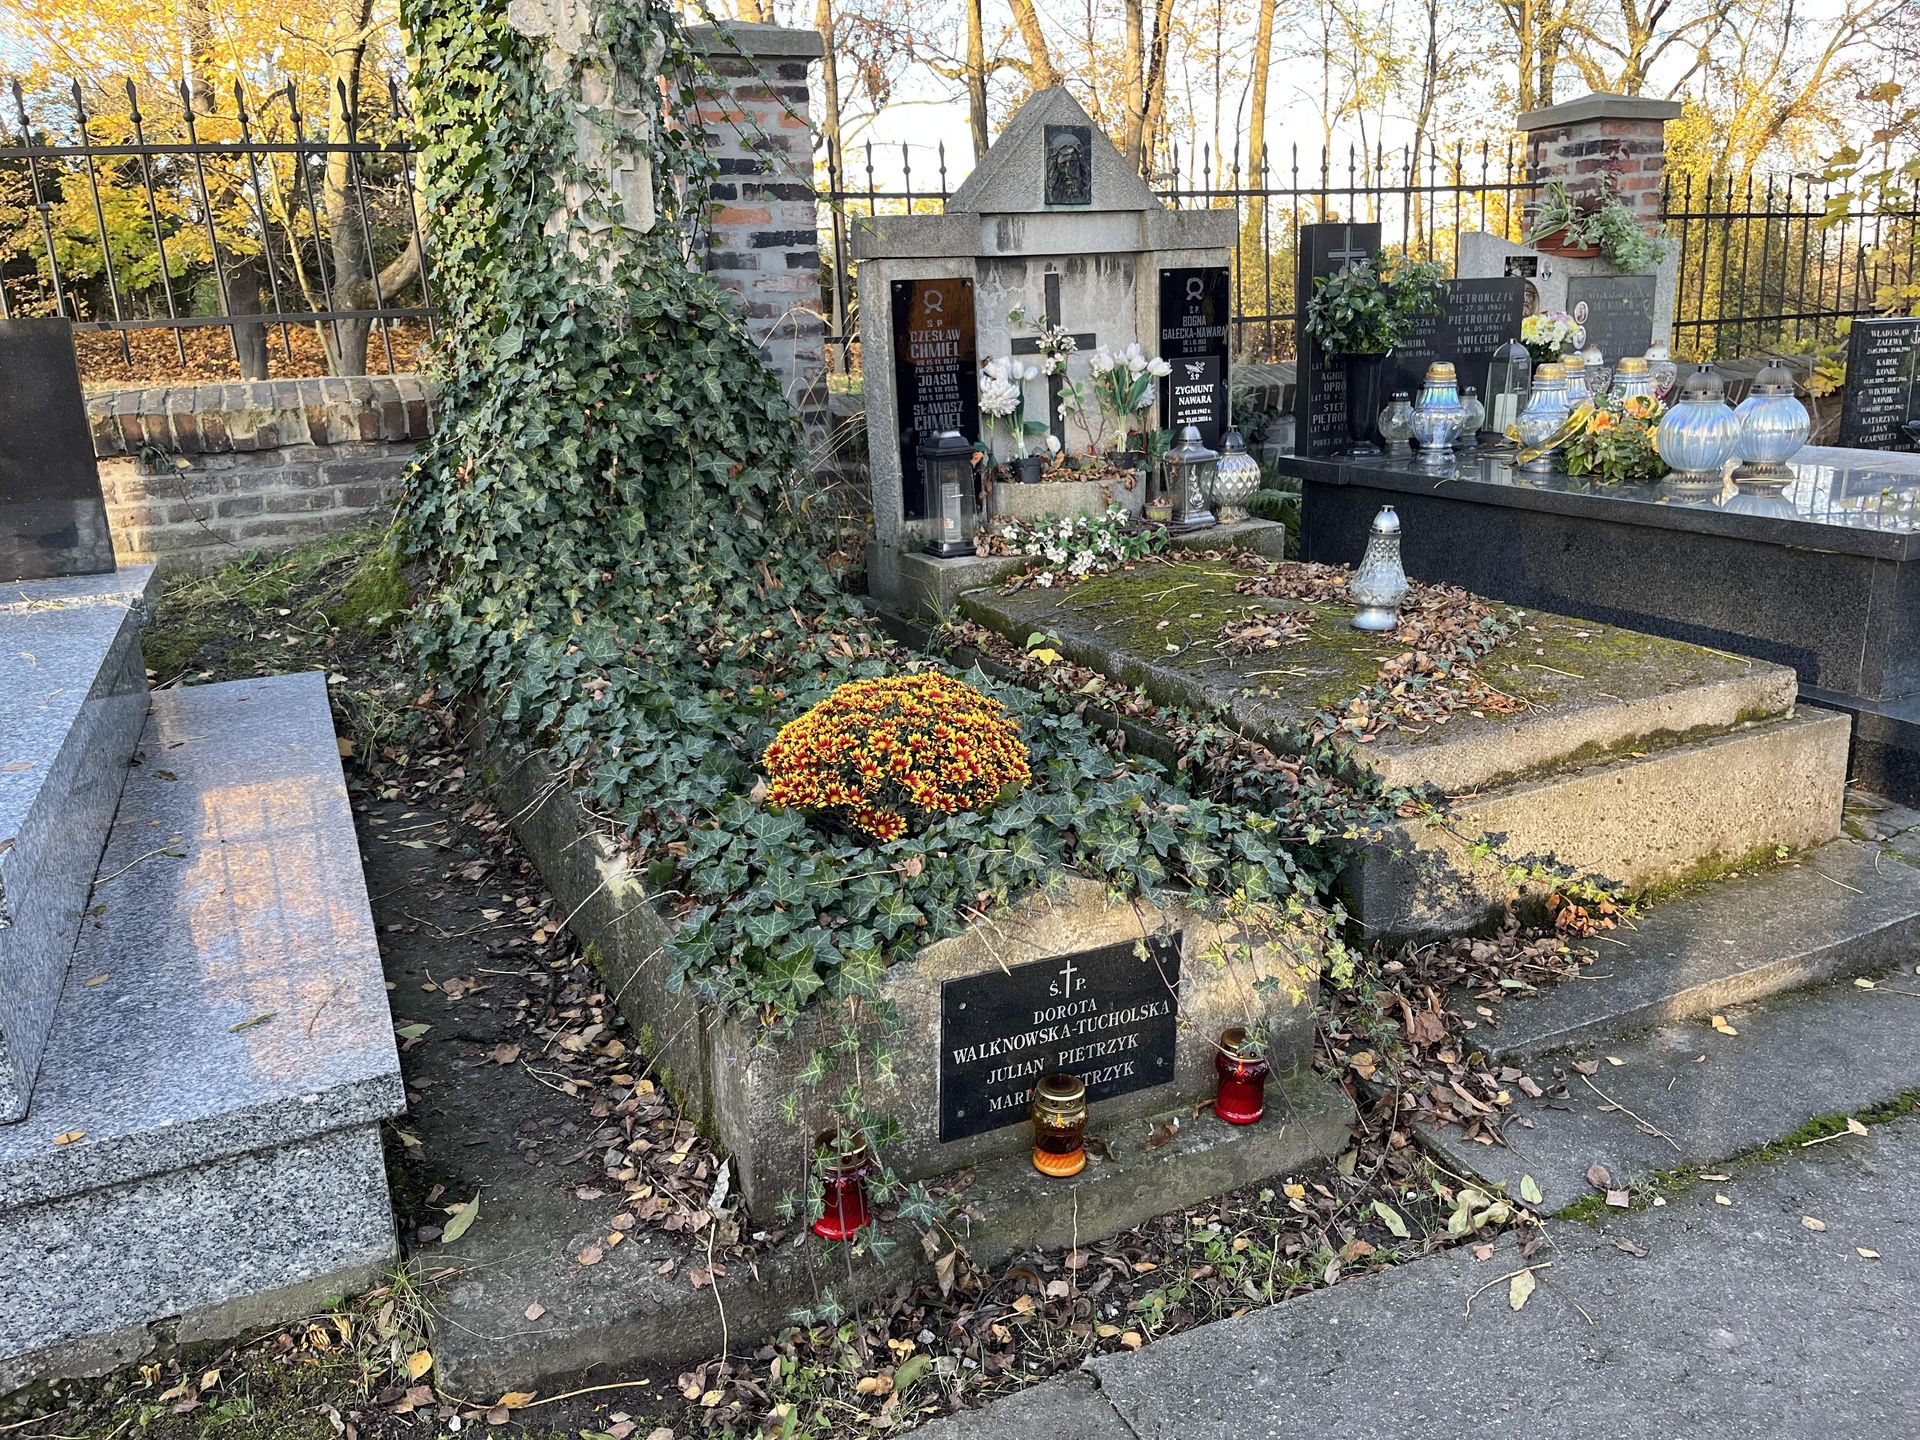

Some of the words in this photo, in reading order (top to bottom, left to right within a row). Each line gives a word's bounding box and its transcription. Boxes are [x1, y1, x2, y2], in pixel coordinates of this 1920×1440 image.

[1182, 315, 1207, 327] BOGNA
[910, 328, 961, 342] CZESŁAW
[1162, 325, 1226, 340] GAŁECKA-NAWARA
[910, 341, 961, 358] CHMIEL
[918, 373, 958, 387] JOASIA
[1321, 371, 1345, 380] AGNIE
[1174, 383, 1215, 395] ZYGMUNT
[1178, 395, 1212, 405] NAWARA
[1323, 402, 1346, 413] STEF
[913, 400, 964, 416] SŁAWOSZ
[914, 412, 965, 431] CHMIEL
[1312, 412, 1346, 424] PIETRO
[1049, 979, 1063, 997] Ś.
[1074, 977, 1087, 991] P.
[1033, 997, 1098, 1025] DOROTA
[952, 999, 1171, 1066] WALKNOWSKA-TUCHOLSKA
[986, 1057, 1046, 1085] JULIAN
[1057, 1032, 1141, 1067] PIETRZYK
[1075, 1060, 1136, 1087] TRZYK
